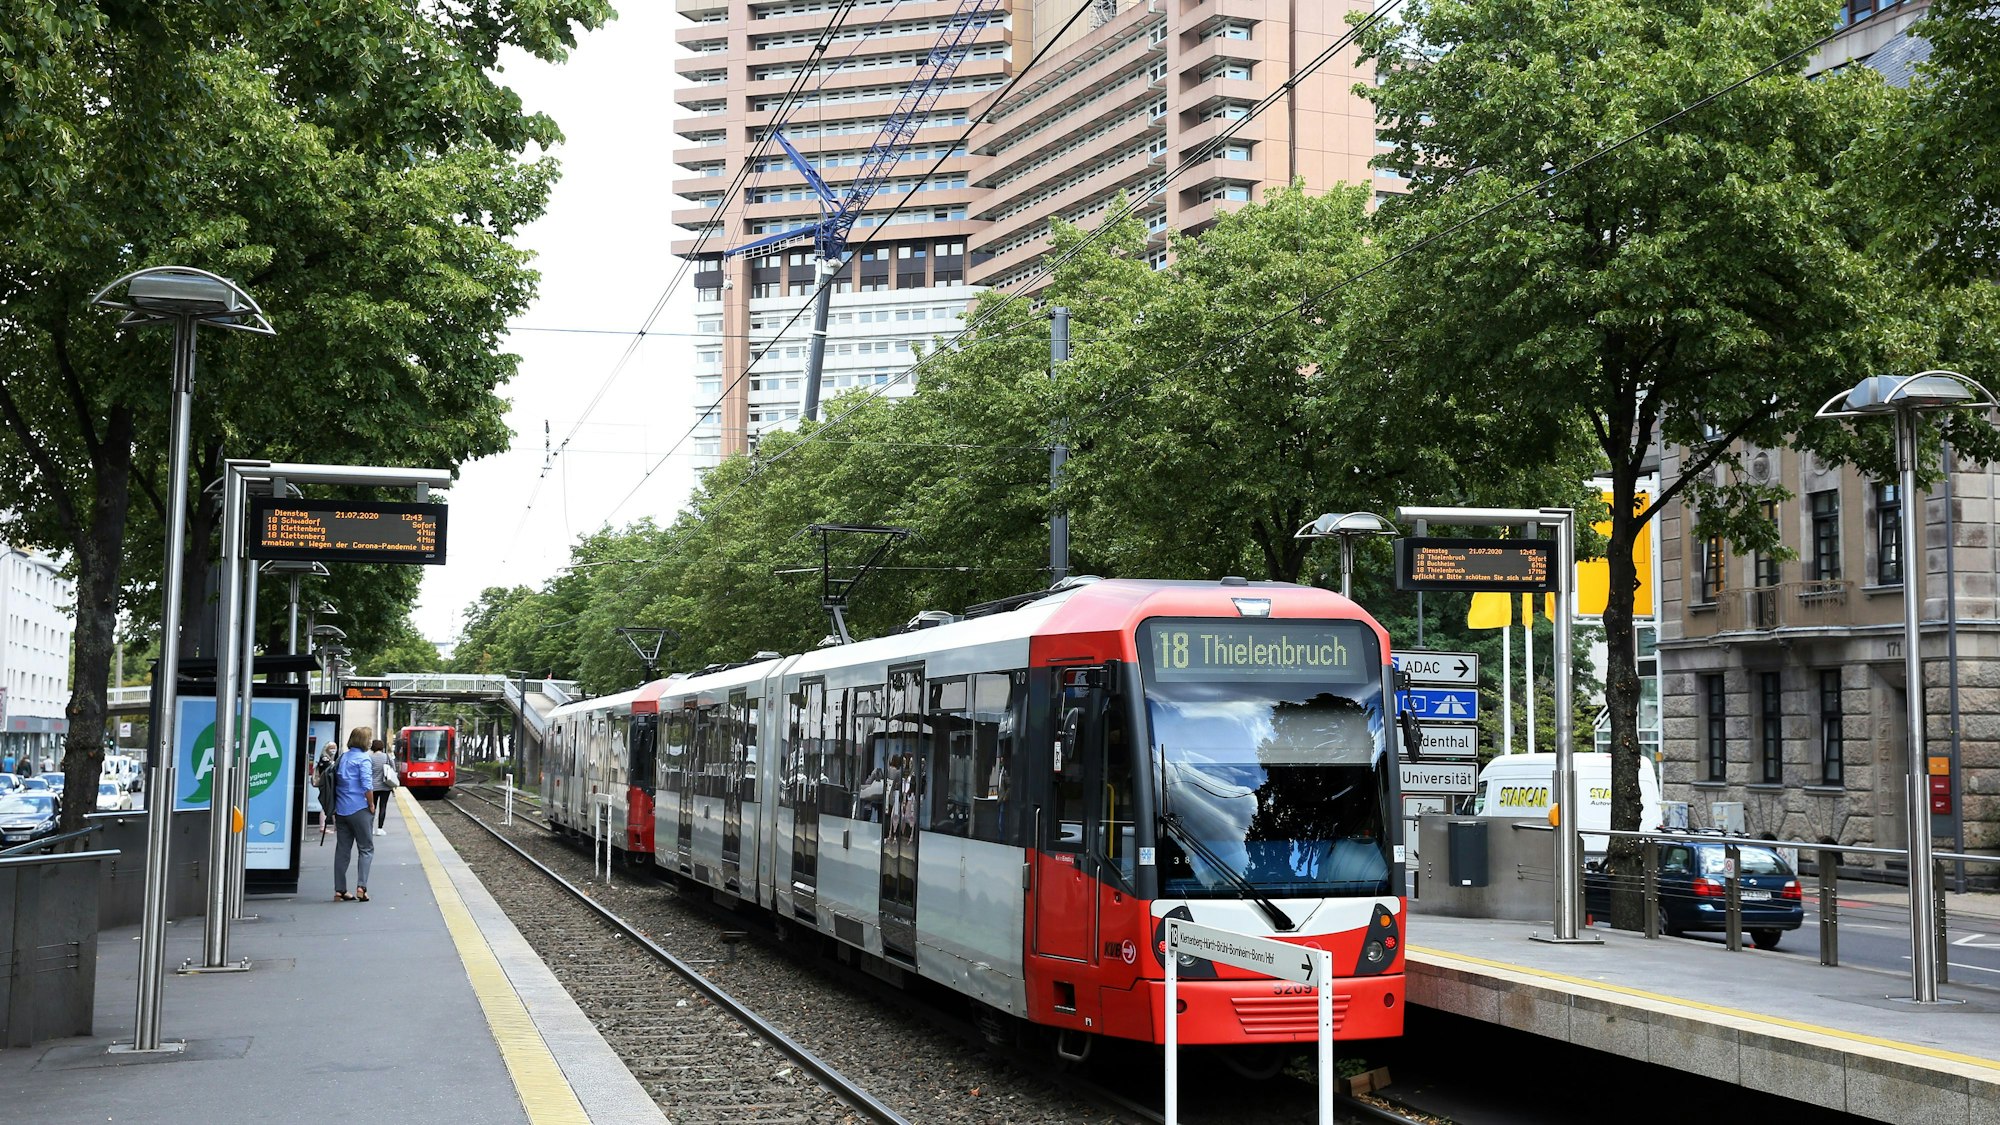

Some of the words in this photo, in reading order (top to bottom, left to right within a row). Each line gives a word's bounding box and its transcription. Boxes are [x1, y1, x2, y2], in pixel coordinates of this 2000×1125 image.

[274, 509, 308, 518] Dienstag
[335, 511, 379, 520] 21.07.2020
[267, 516, 278, 524] 18
[280, 517, 321, 526] Schwadorf
[412, 521, 437, 530] Sofort
[280, 525, 326, 534] Klettenberg
[267, 531, 278, 539] 18
[280, 532, 326, 541] Klettenberg
[308, 541, 332, 549] Wegen
[335, 541, 348, 549] der
[352, 541, 418, 551] Corona-Pandemie
[1422, 547, 1449, 555] Dienstag
[1427, 553, 1466, 561] Thielenbruch
[1528, 555, 1547, 563] Sofort
[1426, 566, 1466, 574] Thielenbruch
[1446, 573, 1462, 581] Bitte
[1465, 573, 1491, 581] schützen
[1493, 573, 1504, 581] Sie
[1159, 631, 1189, 669] 18
[1199, 634, 1348, 666] Thielenbruch
[1886, 641, 1901, 657] 171
[1405, 660, 1441, 674] ADAC
[249, 771, 272, 782] ygiene
[1402, 771, 1472, 785] Universität
[1499, 786, 1549, 808] STARCAR
[1171, 924, 1178, 947] 18
[1273, 984, 1312, 996] 5209
